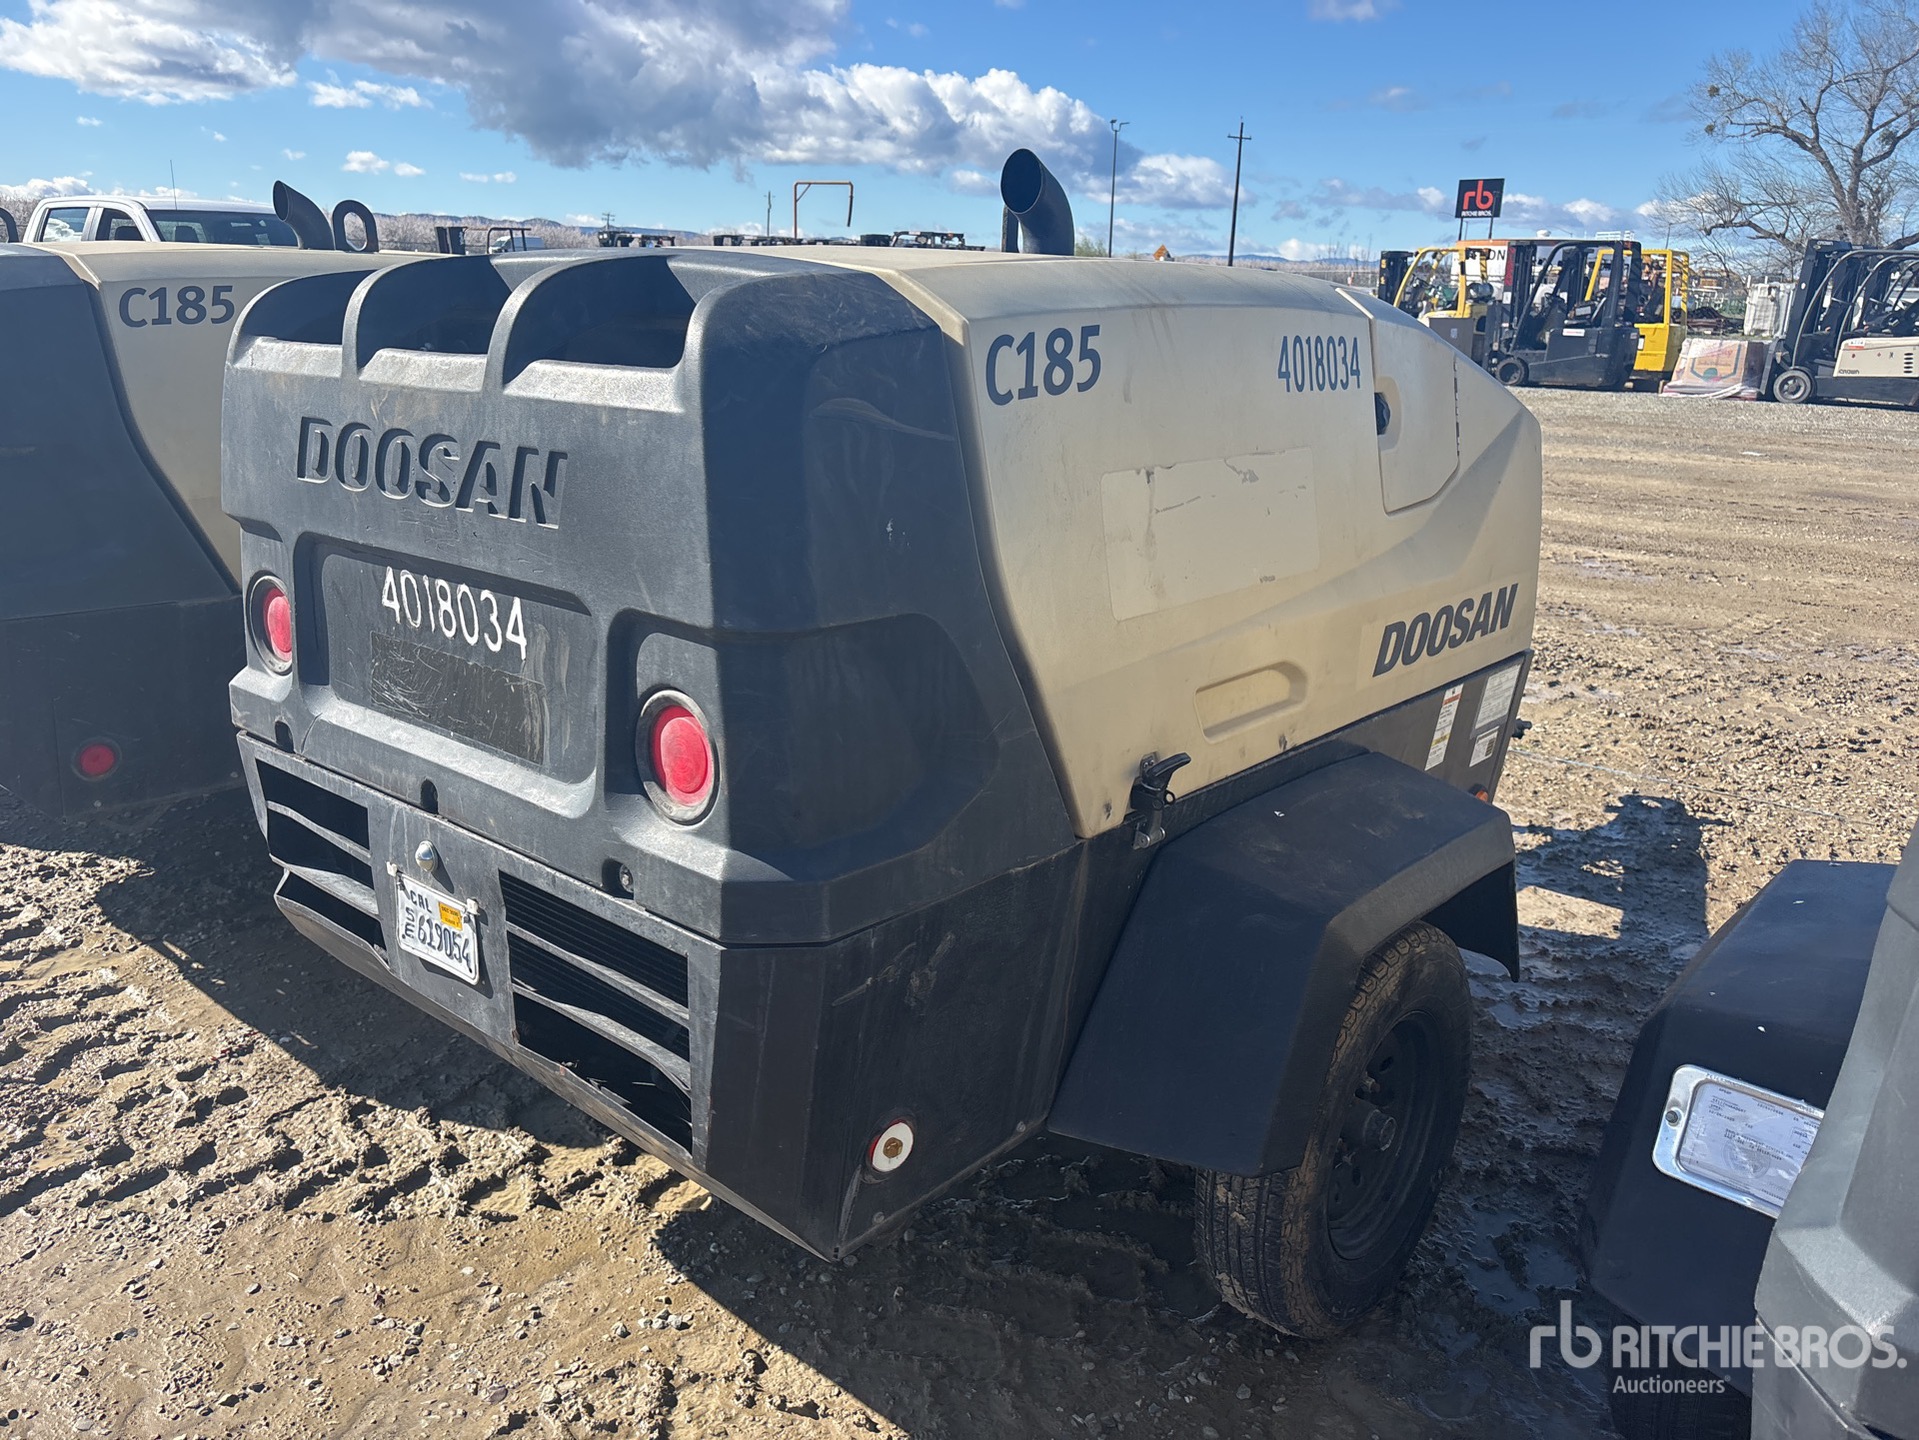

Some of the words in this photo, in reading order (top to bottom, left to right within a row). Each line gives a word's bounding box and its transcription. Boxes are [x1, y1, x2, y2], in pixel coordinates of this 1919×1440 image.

[1463, 180, 1493, 210] rb
[119, 285, 235, 328] C185
[986, 324, 1102, 406] C185
[1277, 335, 1361, 393] 4018034
[297, 416, 569, 530] DOOSAN
[381, 566, 528, 661] 4018034
[1372, 583, 1519, 678] DOOSAN
[410, 889, 432, 914] CAL
[417, 913, 473, 974] 619054
